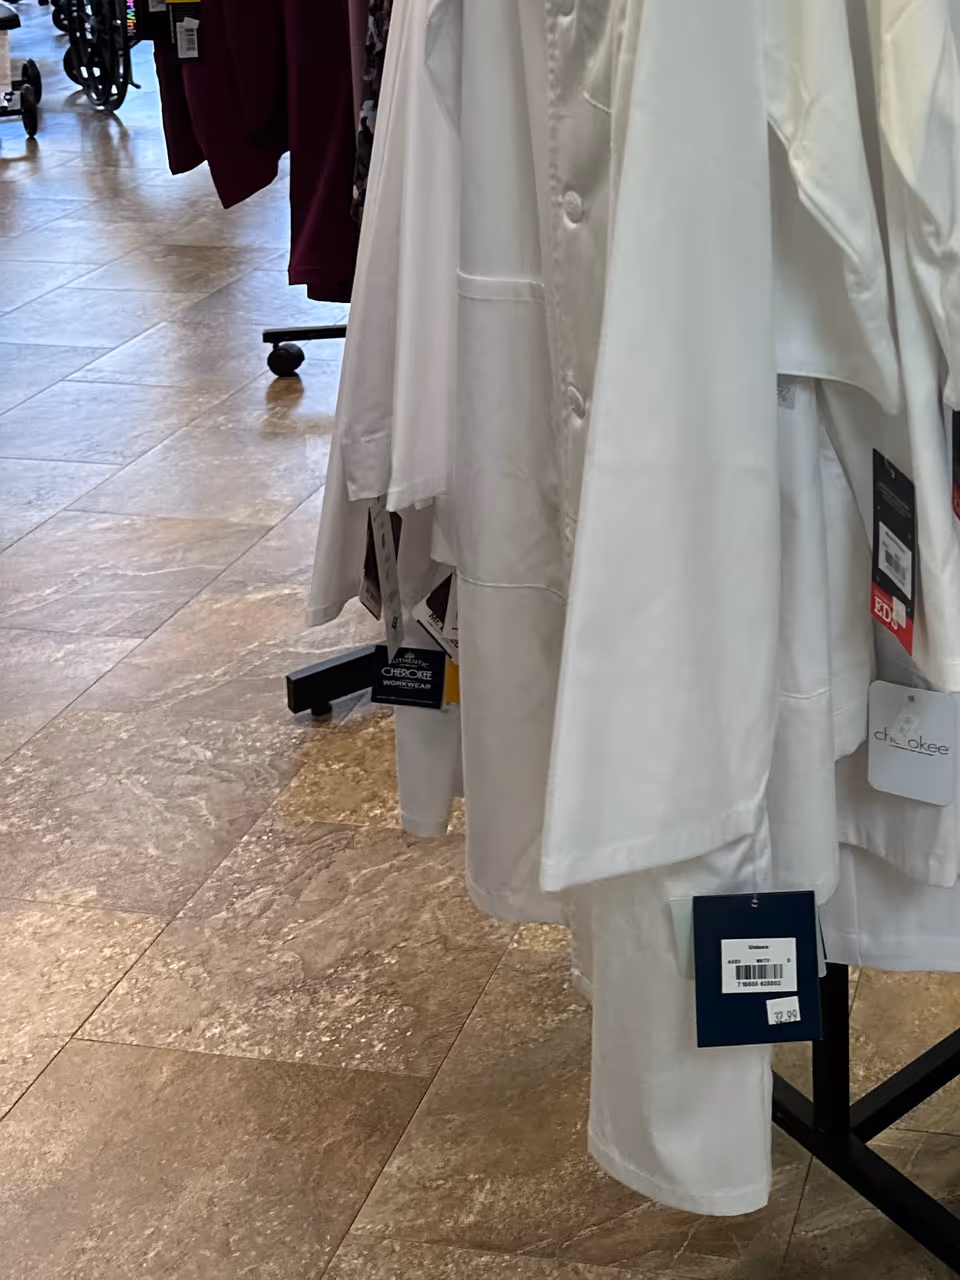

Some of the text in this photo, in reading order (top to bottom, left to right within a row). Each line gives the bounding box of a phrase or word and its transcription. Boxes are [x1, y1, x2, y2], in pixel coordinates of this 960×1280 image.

[390, 657, 429, 668] UTHENTIC
[381, 666, 433, 681] CHEROKEE
[382, 679, 432, 689] WORKWEAR
